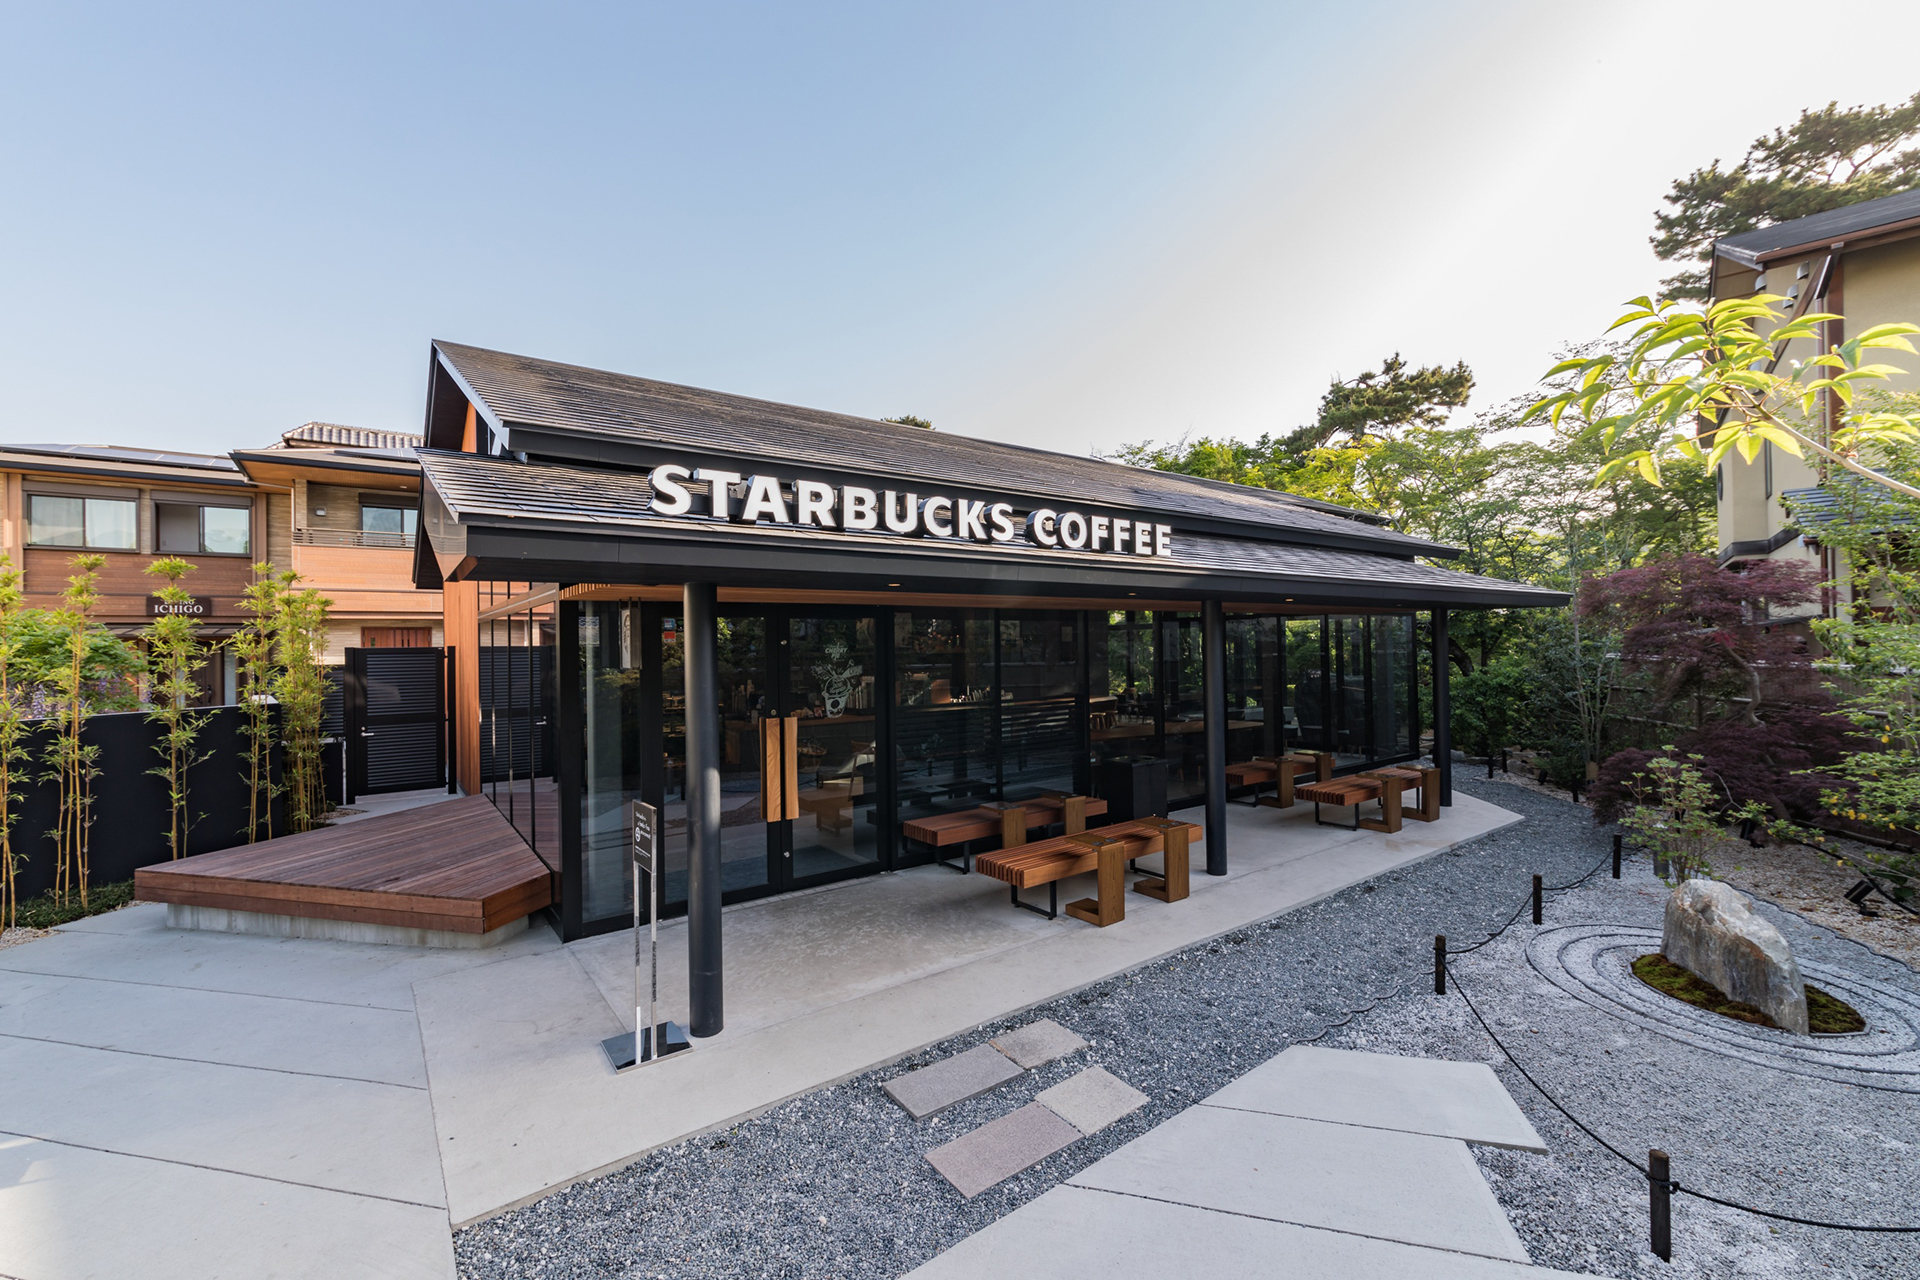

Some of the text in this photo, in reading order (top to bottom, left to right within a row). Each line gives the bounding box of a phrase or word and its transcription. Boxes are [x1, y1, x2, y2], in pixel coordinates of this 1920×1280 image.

[648, 464, 1172, 557] STARBUCKS COFFEE
[154, 604, 203, 614] ICHIGO
